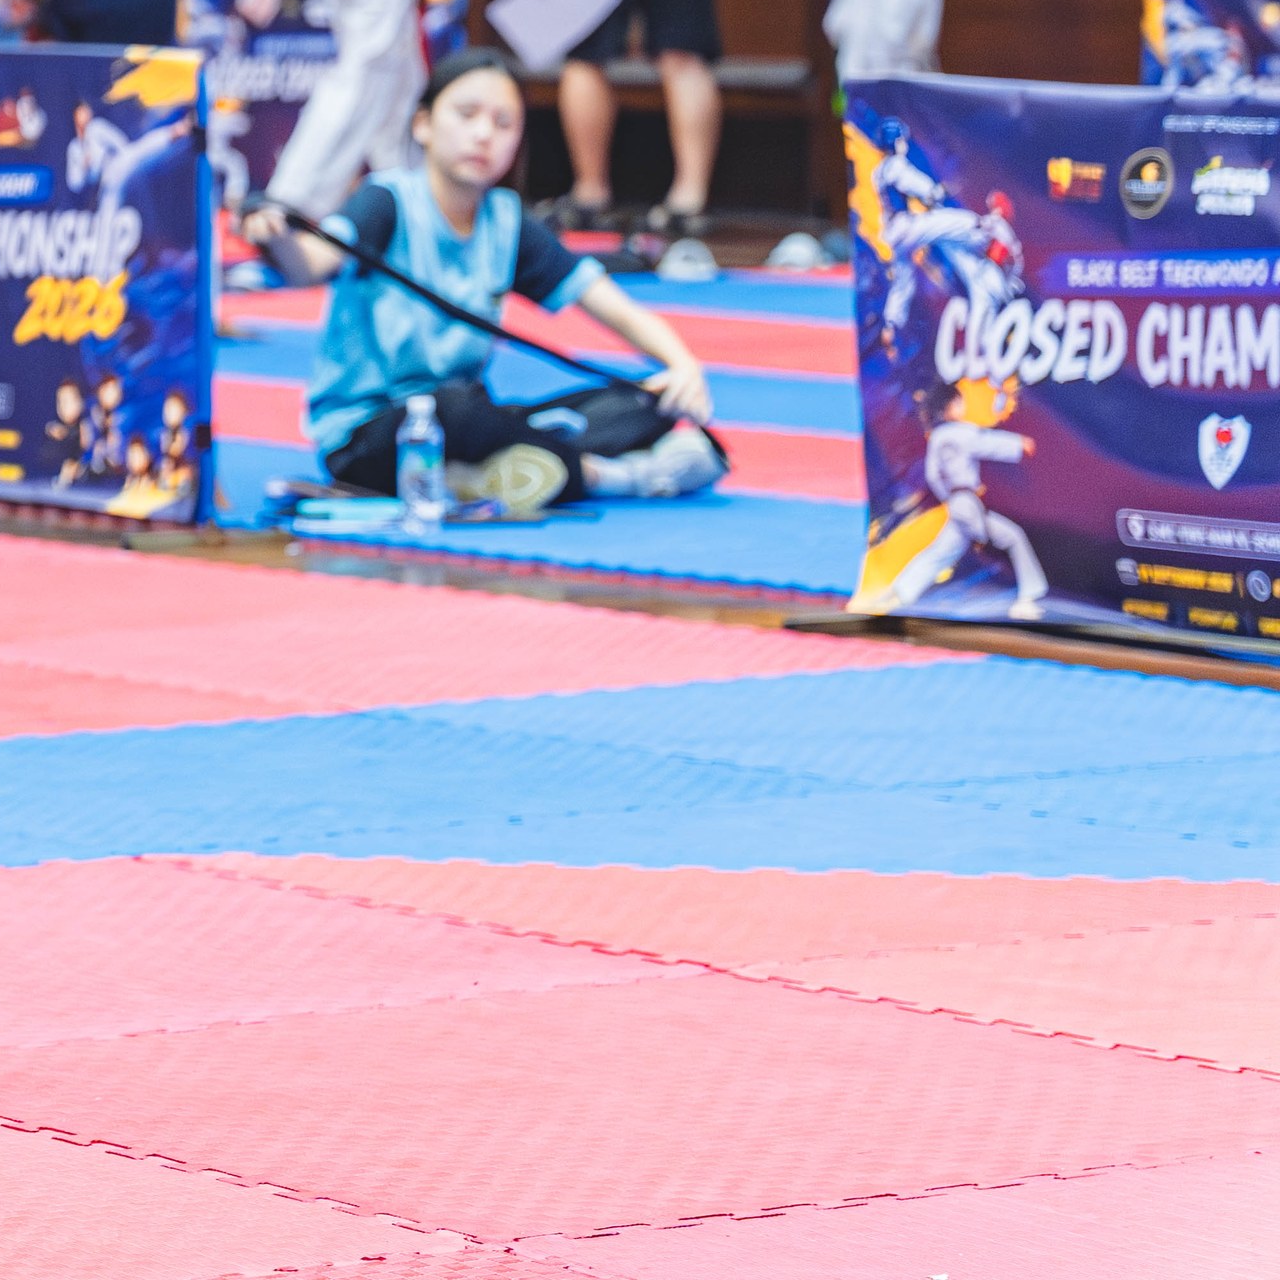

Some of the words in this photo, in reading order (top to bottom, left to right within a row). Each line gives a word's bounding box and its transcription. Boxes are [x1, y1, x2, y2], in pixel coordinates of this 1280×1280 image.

[13, 270, 129, 345] 2026
[934, 295, 1128, 387] CLOSED
[1136, 301, 1280, 389] CHAM
